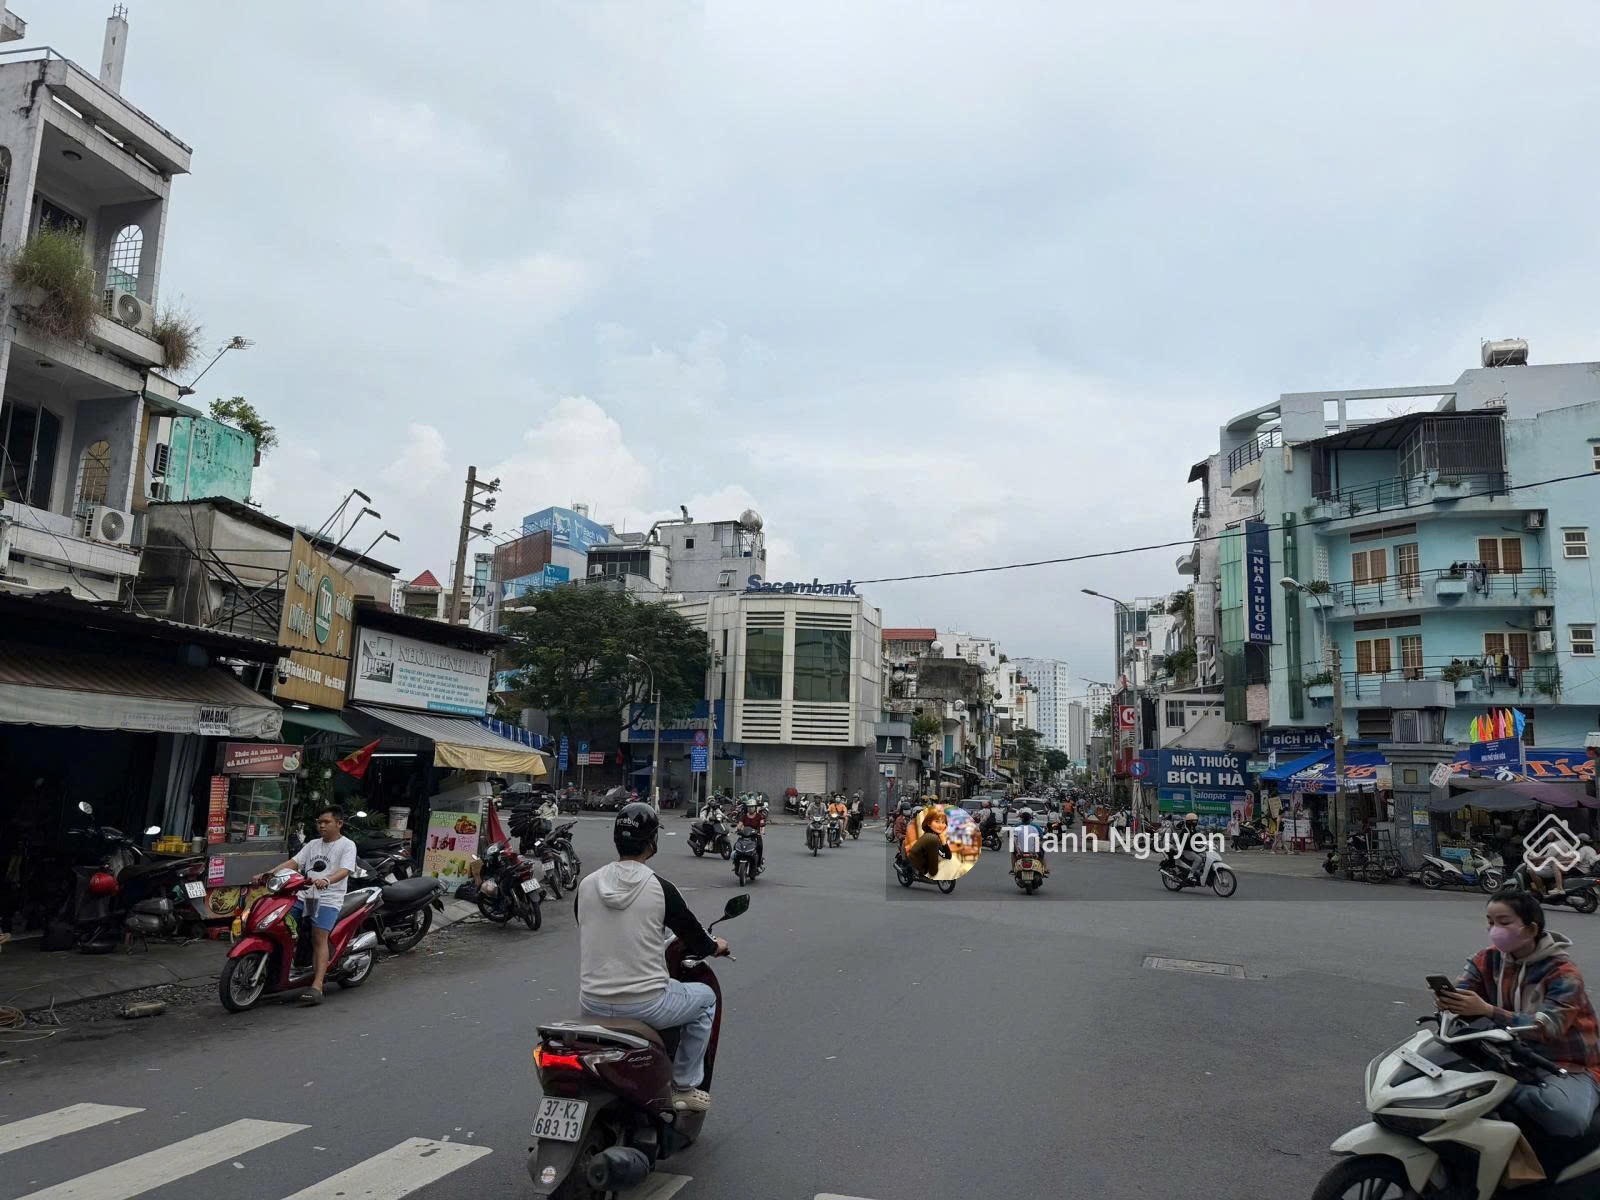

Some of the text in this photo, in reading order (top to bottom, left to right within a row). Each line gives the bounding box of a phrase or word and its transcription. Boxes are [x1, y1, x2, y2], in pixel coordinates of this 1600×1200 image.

[746, 574, 856, 595] Sacombank
[1253, 556, 1267, 631] NHÀ THUỐC
[1272, 732, 1322, 744] BÍCH HÀ
[1172, 752, 1238, 768] NHÀ THUỐC
[1167, 768, 1244, 786] BÍCH HÀ
[544, 1100, 580, 1120] 37-K2
[535, 1118, 579, 1138] 683.13
